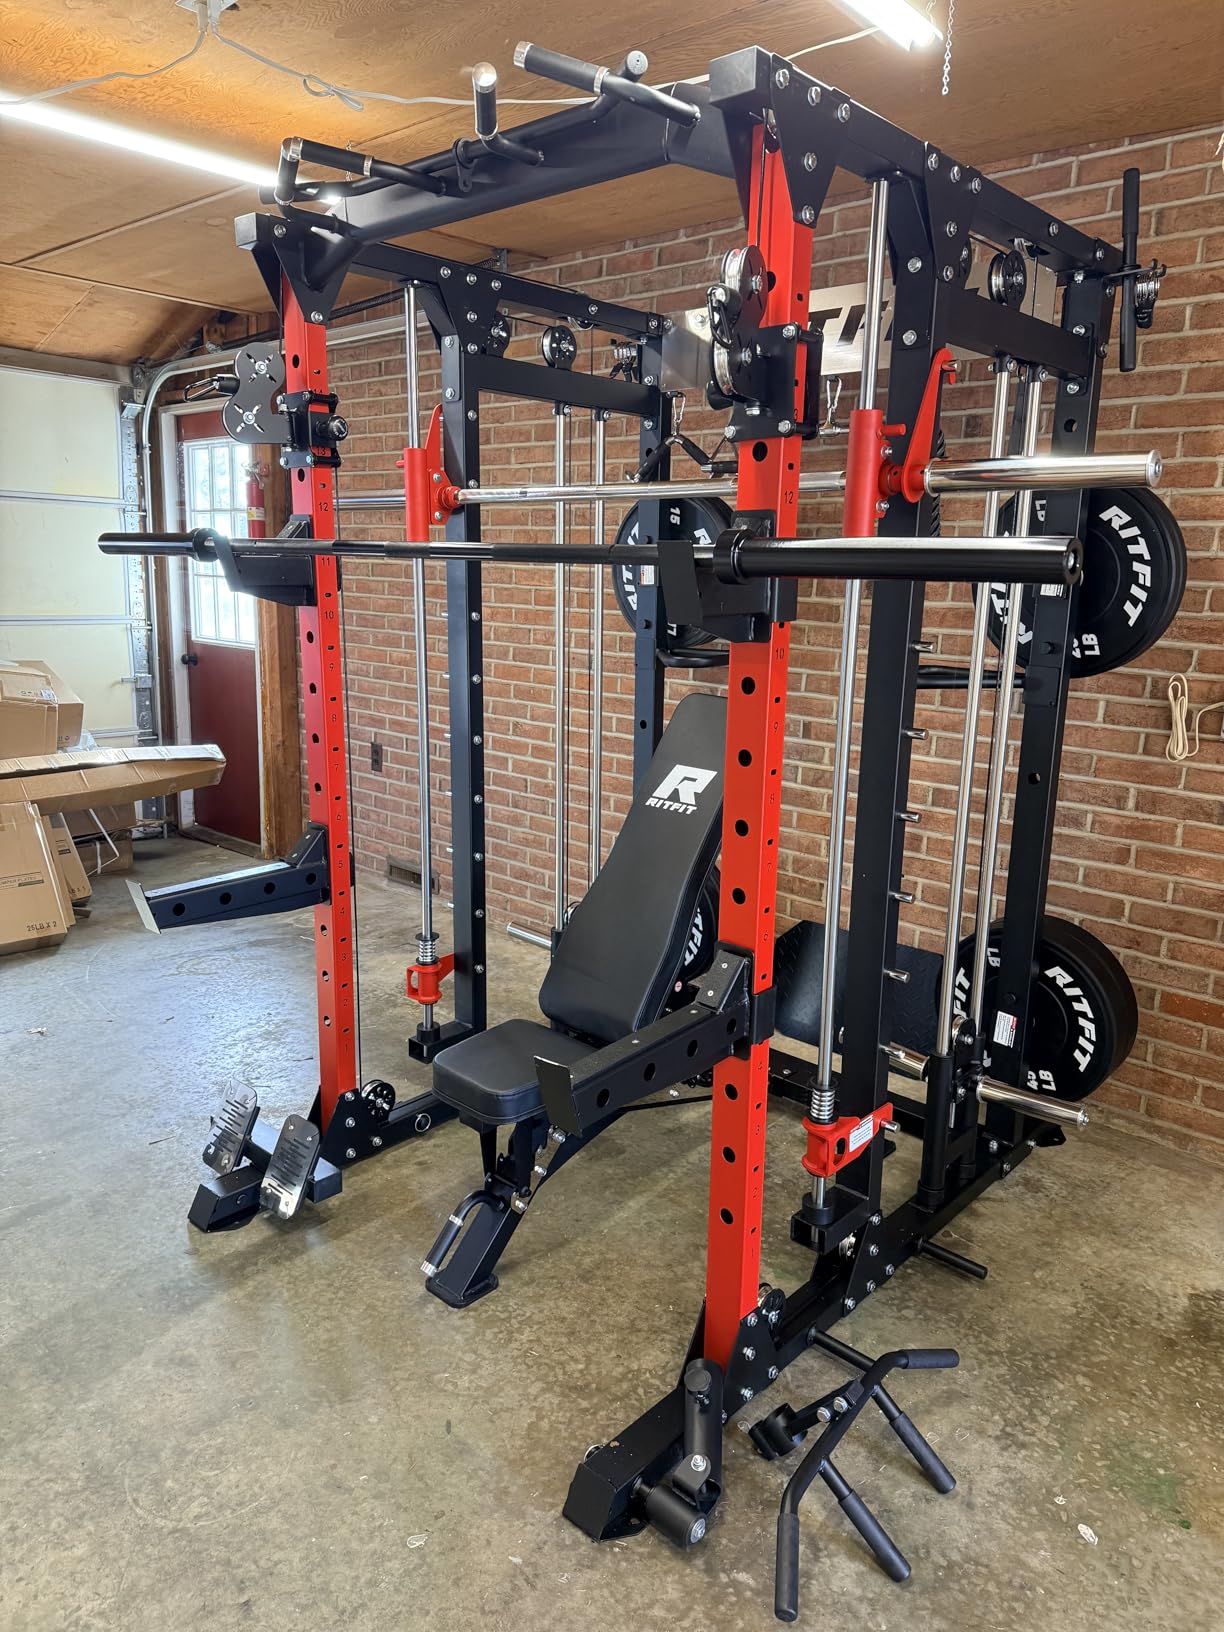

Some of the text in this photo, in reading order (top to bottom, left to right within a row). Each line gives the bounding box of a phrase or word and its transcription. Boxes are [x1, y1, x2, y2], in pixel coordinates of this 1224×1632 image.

[784, 490, 794, 504] 12
[318, 502, 329, 512] 12
[671, 507, 681, 525] 15
[321, 557, 331, 567] 11
[1099, 505, 1151, 627] RITFIT
[324, 610, 335, 620] 10
[1082, 633, 1100, 656] LB
[775, 647, 785, 659] 10
[329, 662, 335, 672] 9
[331, 713, 337, 722] 8
[773, 721, 779, 733] 9
[645, 797, 698, 815] RITFIT
[27, 923, 44, 932] 25LB
[1044, 966, 1096, 1073] RITFIT
[1039, 1070, 1056, 1091] LB
